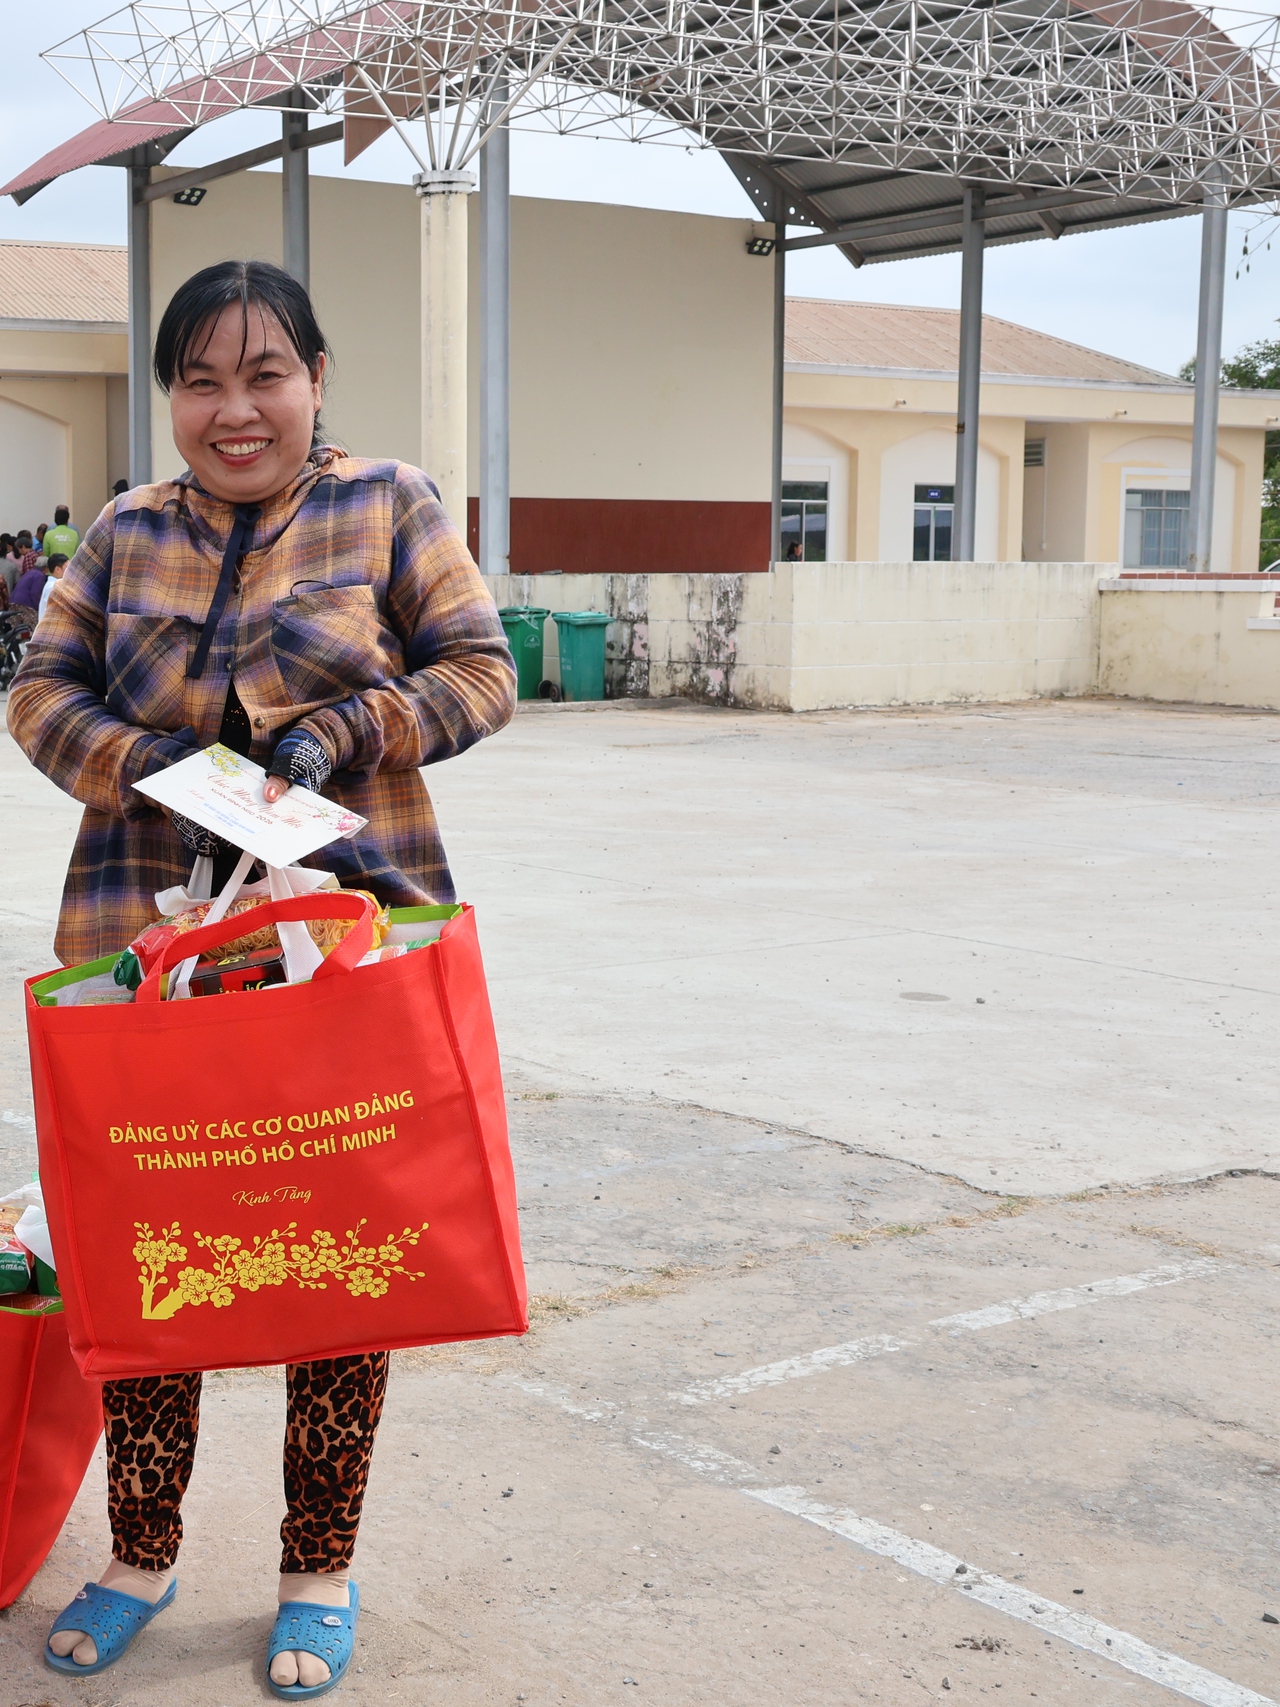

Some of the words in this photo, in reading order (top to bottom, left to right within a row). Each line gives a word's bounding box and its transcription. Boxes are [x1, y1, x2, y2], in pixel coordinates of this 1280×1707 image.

[256, 815, 273, 825] 2026
[109, 1121, 168, 1143] ĐẢNG
[172, 1119, 200, 1141] UỶ
[205, 1119, 248, 1139] CÁC
[251, 1116, 283, 1136] CƠ
[287, 1106, 351, 1132] QUAN
[354, 1090, 415, 1120] ĐẢNG
[134, 1150, 208, 1170] THÀNH
[212, 1143, 257, 1167] PHỐ
[262, 1139, 295, 1163] HỒ
[299, 1133, 337, 1158] CHÍ
[341, 1123, 397, 1152] MINH
[273, 1186, 312, 1204] Tặng
